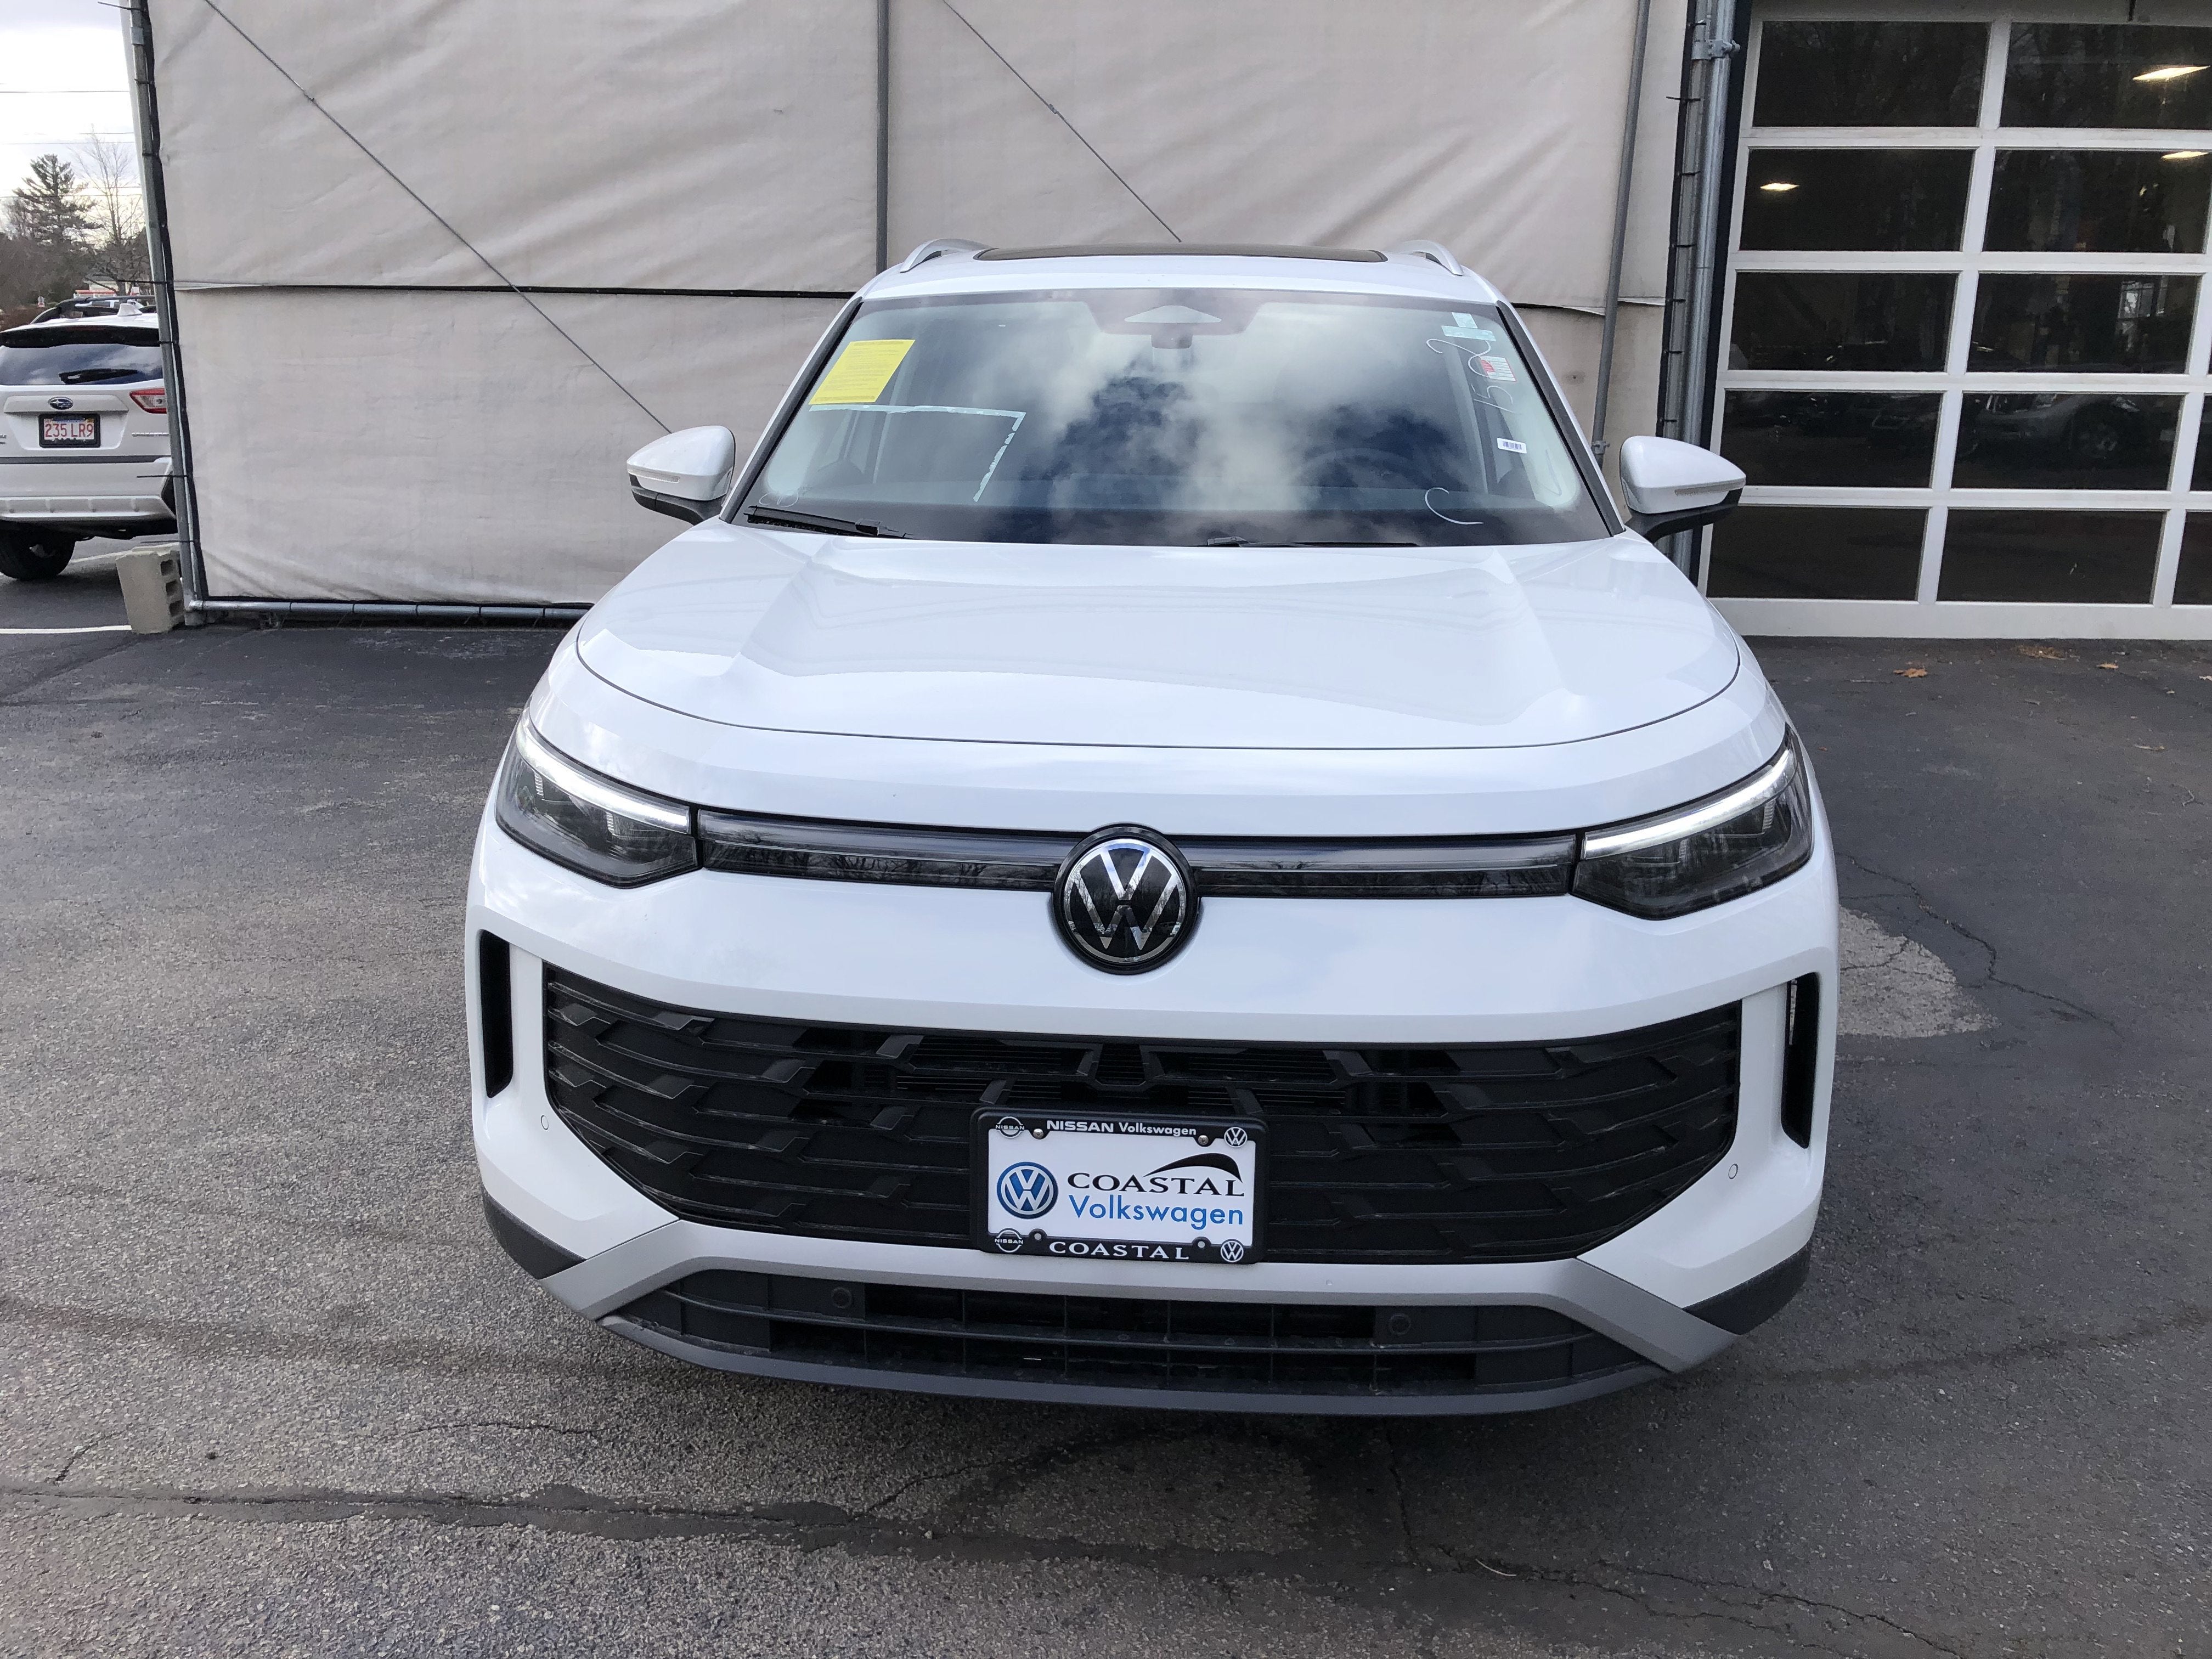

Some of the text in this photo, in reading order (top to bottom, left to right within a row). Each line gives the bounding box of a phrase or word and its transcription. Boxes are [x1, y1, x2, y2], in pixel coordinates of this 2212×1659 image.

[45, 424, 93, 437] 235 LR9
[1065, 839, 1185, 961] VW
[1047, 1120, 1197, 1136] NISSAN Volkswagen
[1002, 1166, 1053, 1215] VW
[1067, 1172, 1245, 1197] COASTAL
[1068, 1193, 1244, 1230] Volkswagen
[1049, 1242, 1190, 1260] COASTAL
